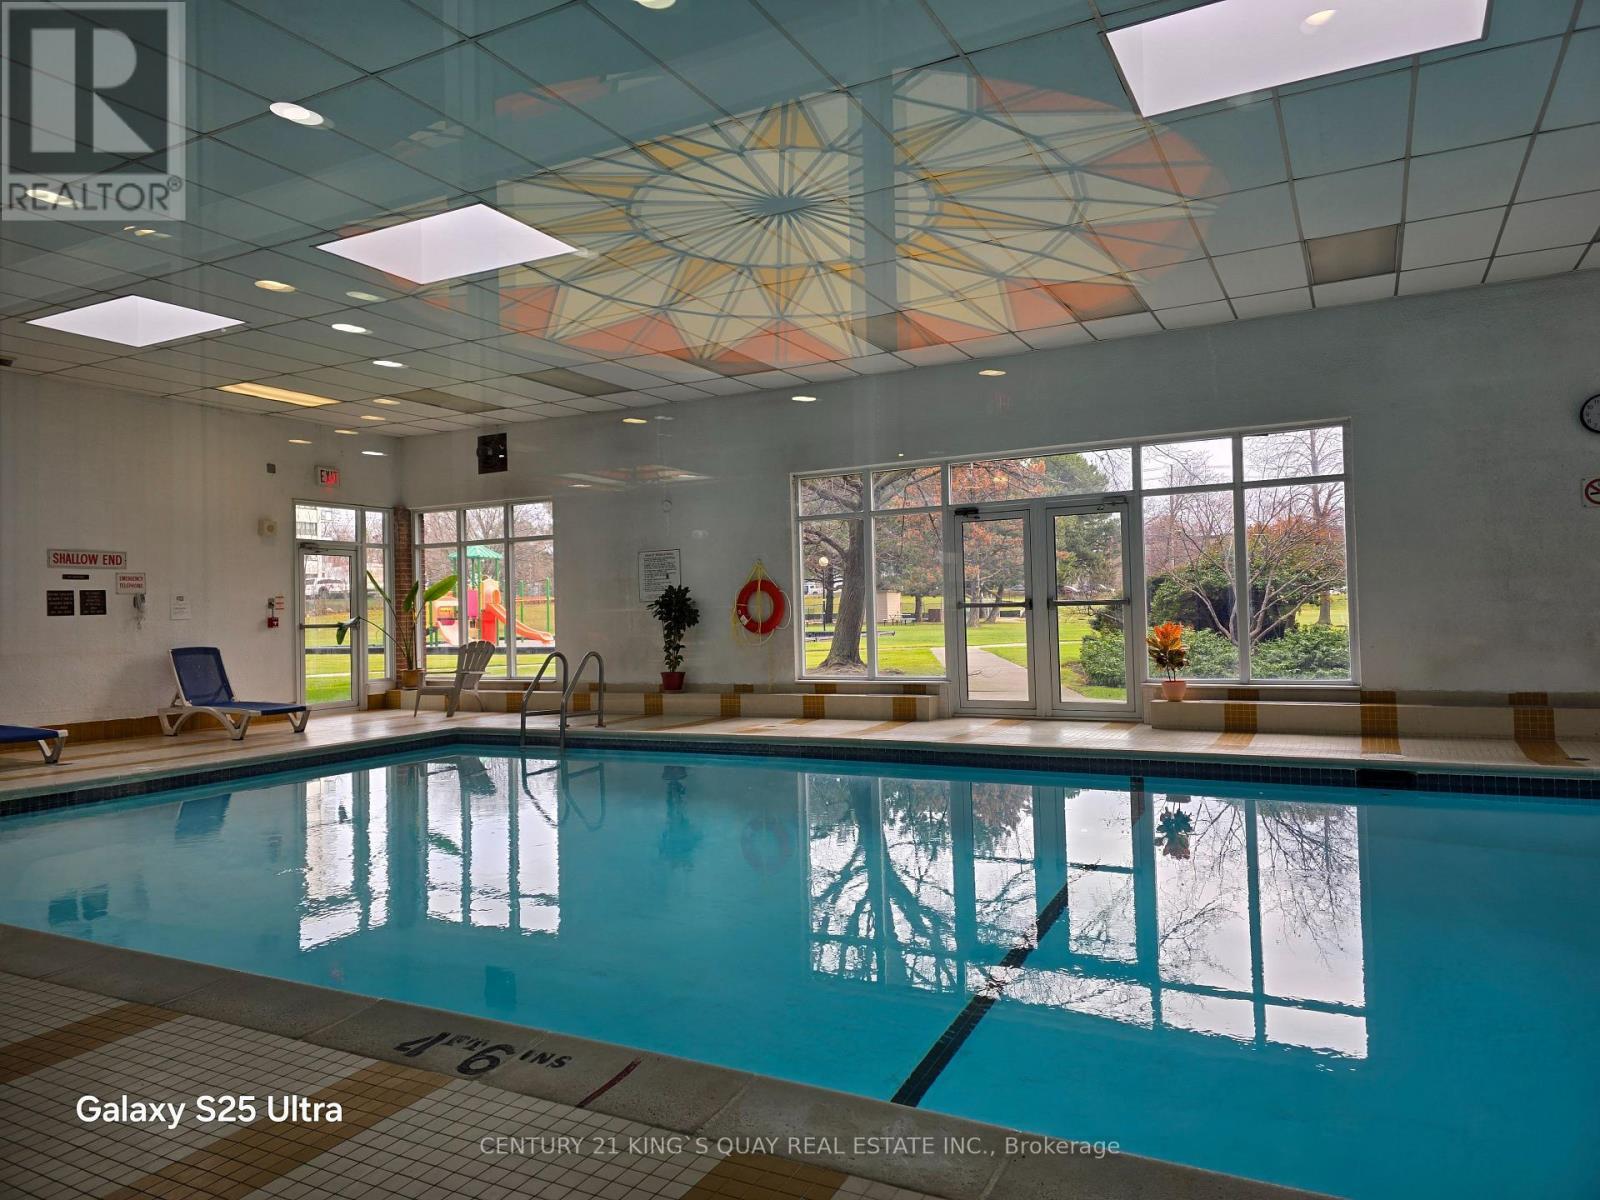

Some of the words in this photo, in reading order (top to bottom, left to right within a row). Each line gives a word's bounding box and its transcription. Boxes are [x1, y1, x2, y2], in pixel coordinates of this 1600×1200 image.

[52, 552, 98, 566] SHALLOW
[103, 554, 122, 566] END
[393, 1031, 450, 1057] 4
[456, 1044, 516, 1076] 6
[519, 1049, 572, 1069] INS
